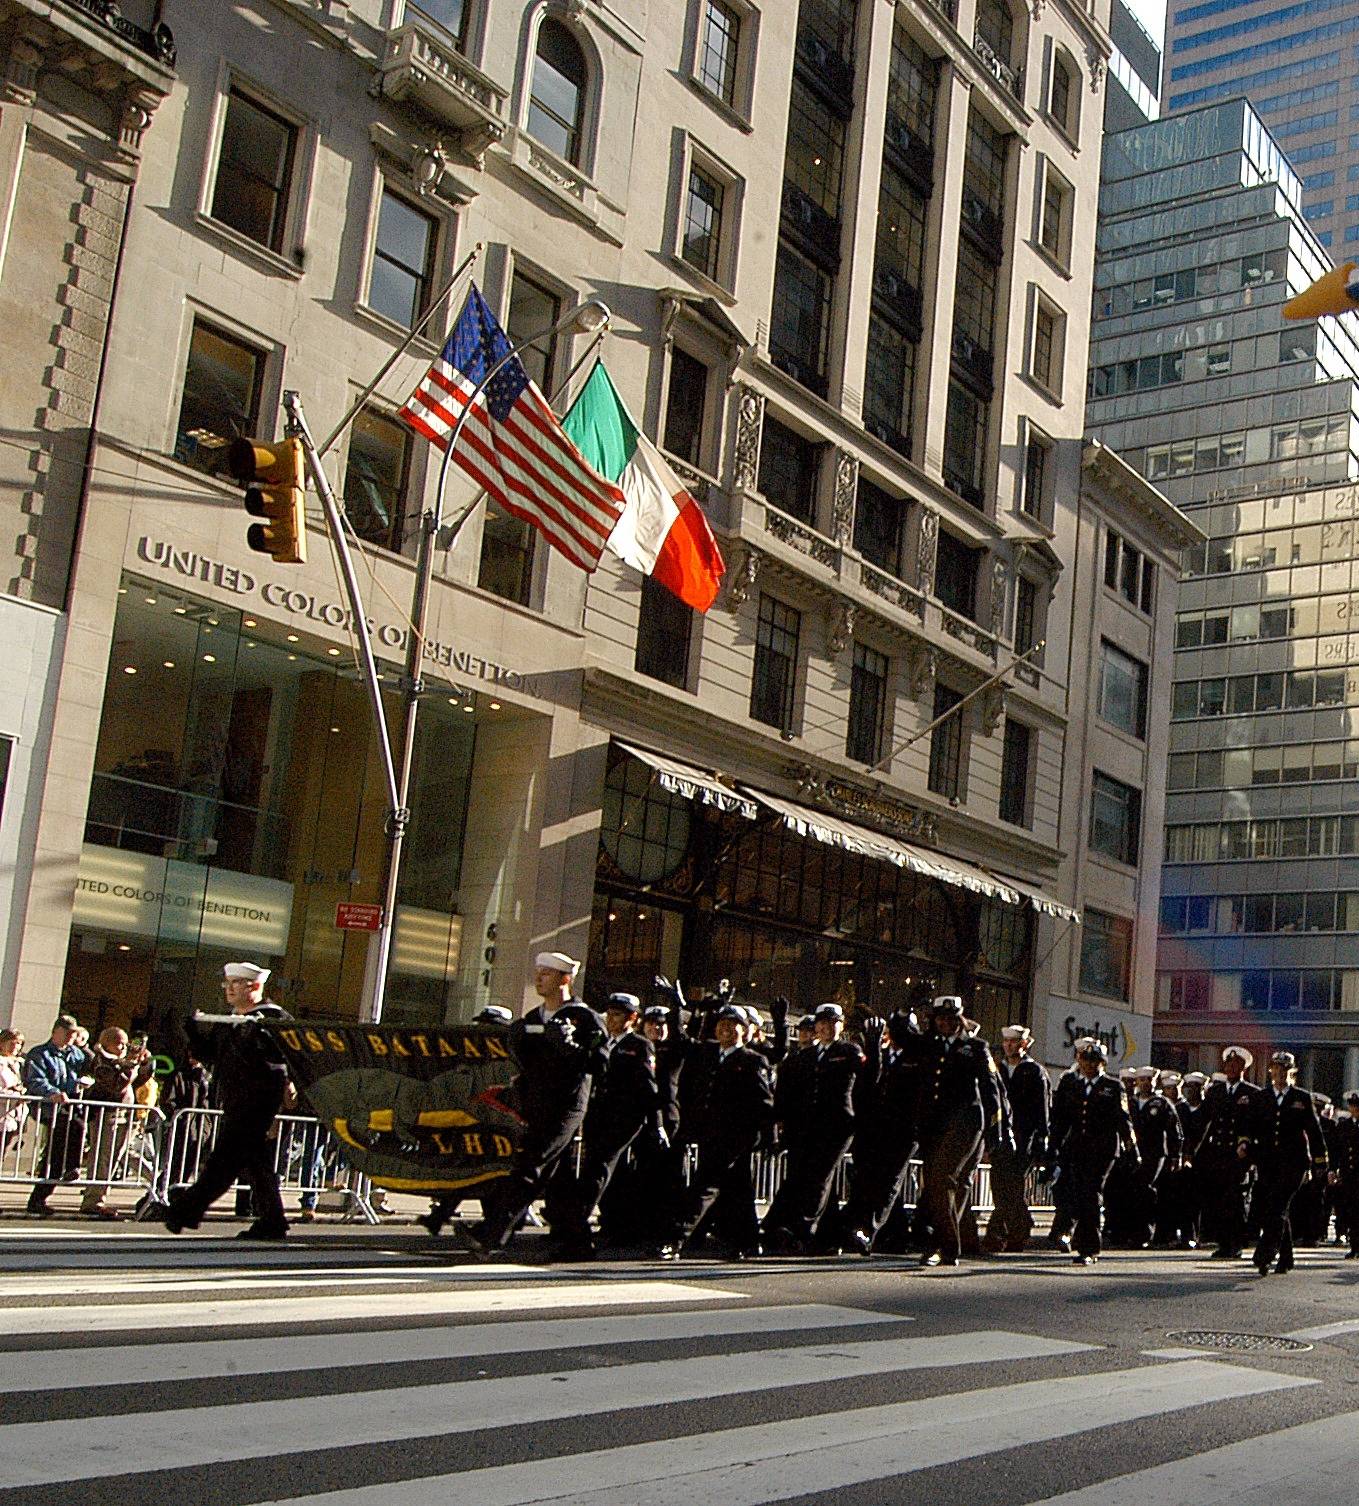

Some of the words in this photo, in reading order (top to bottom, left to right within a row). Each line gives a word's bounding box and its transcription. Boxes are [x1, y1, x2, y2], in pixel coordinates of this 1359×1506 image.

[137, 536, 257, 595] UNITED
[423, 637, 543, 700] BENETTON
[76, 878, 109, 893] ITED
[112, 885, 171, 905] COLORS
[279, 1029, 346, 1051] USS
[368, 1033, 510, 1058] BATAAN
